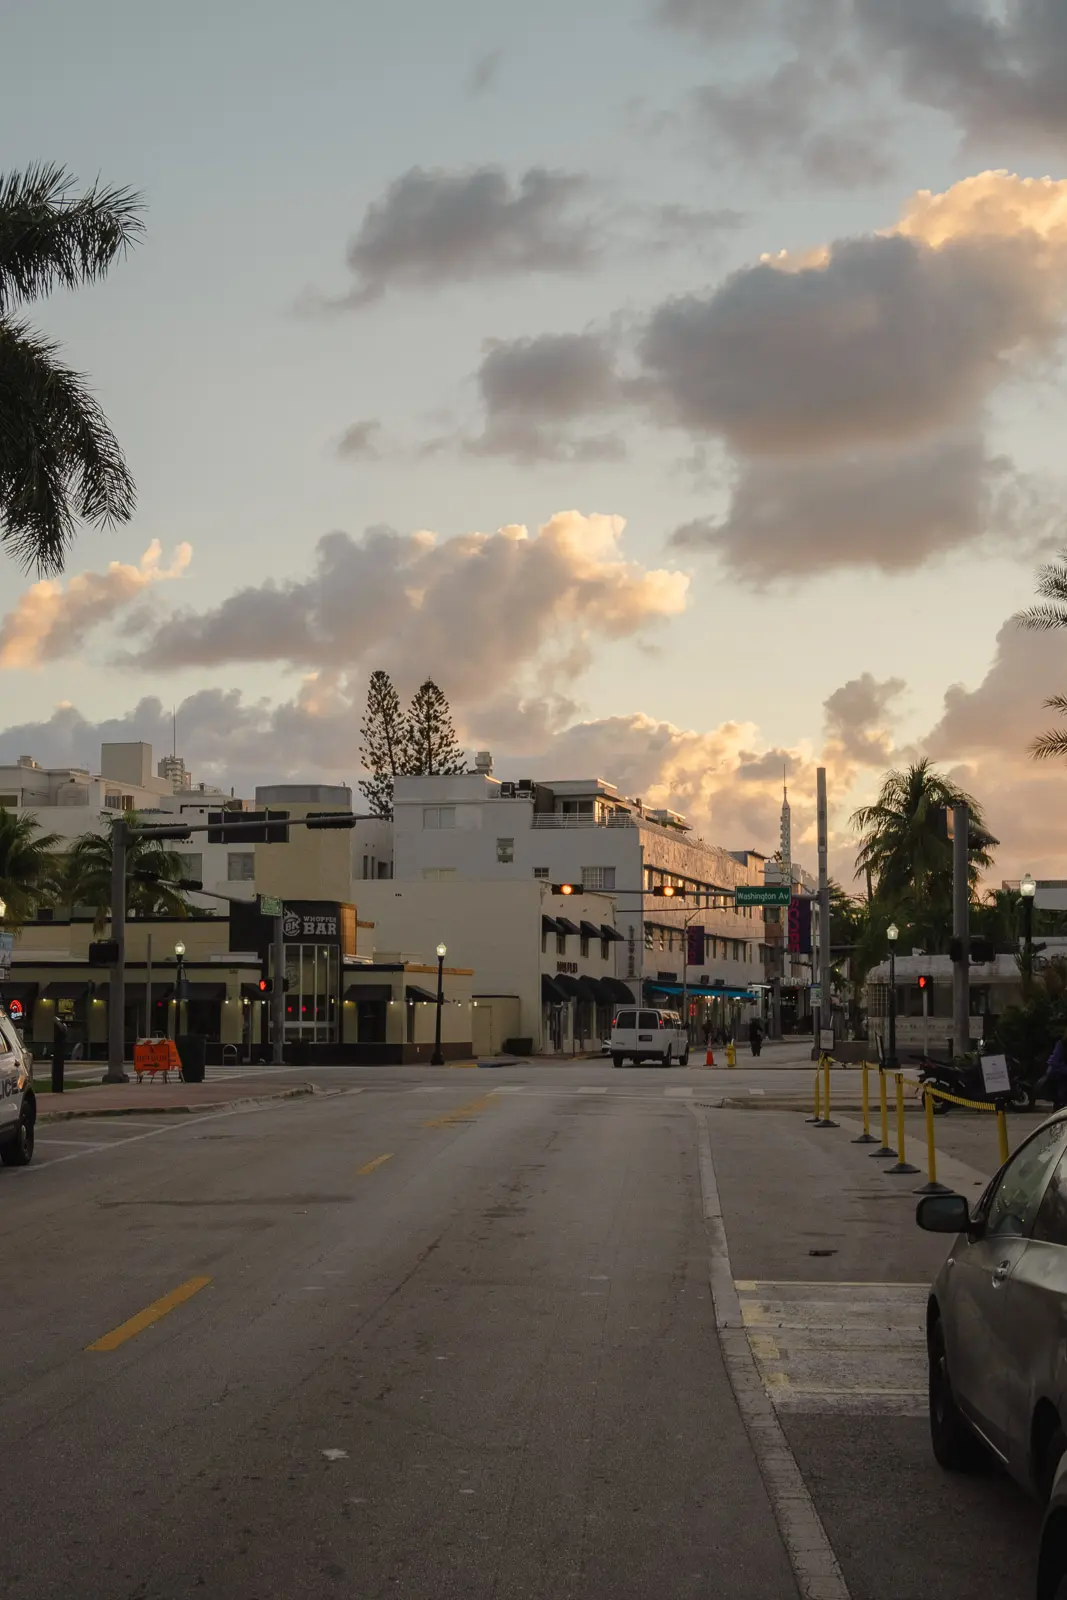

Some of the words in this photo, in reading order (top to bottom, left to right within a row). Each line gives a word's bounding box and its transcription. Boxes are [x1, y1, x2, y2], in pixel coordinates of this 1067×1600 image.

[737, 891, 777, 902] Washington
[778, 891, 789, 900] Av
[285, 921, 299, 932] BK
[303, 922, 337, 935] BAR
[0, 1076, 18, 1099] ICE
